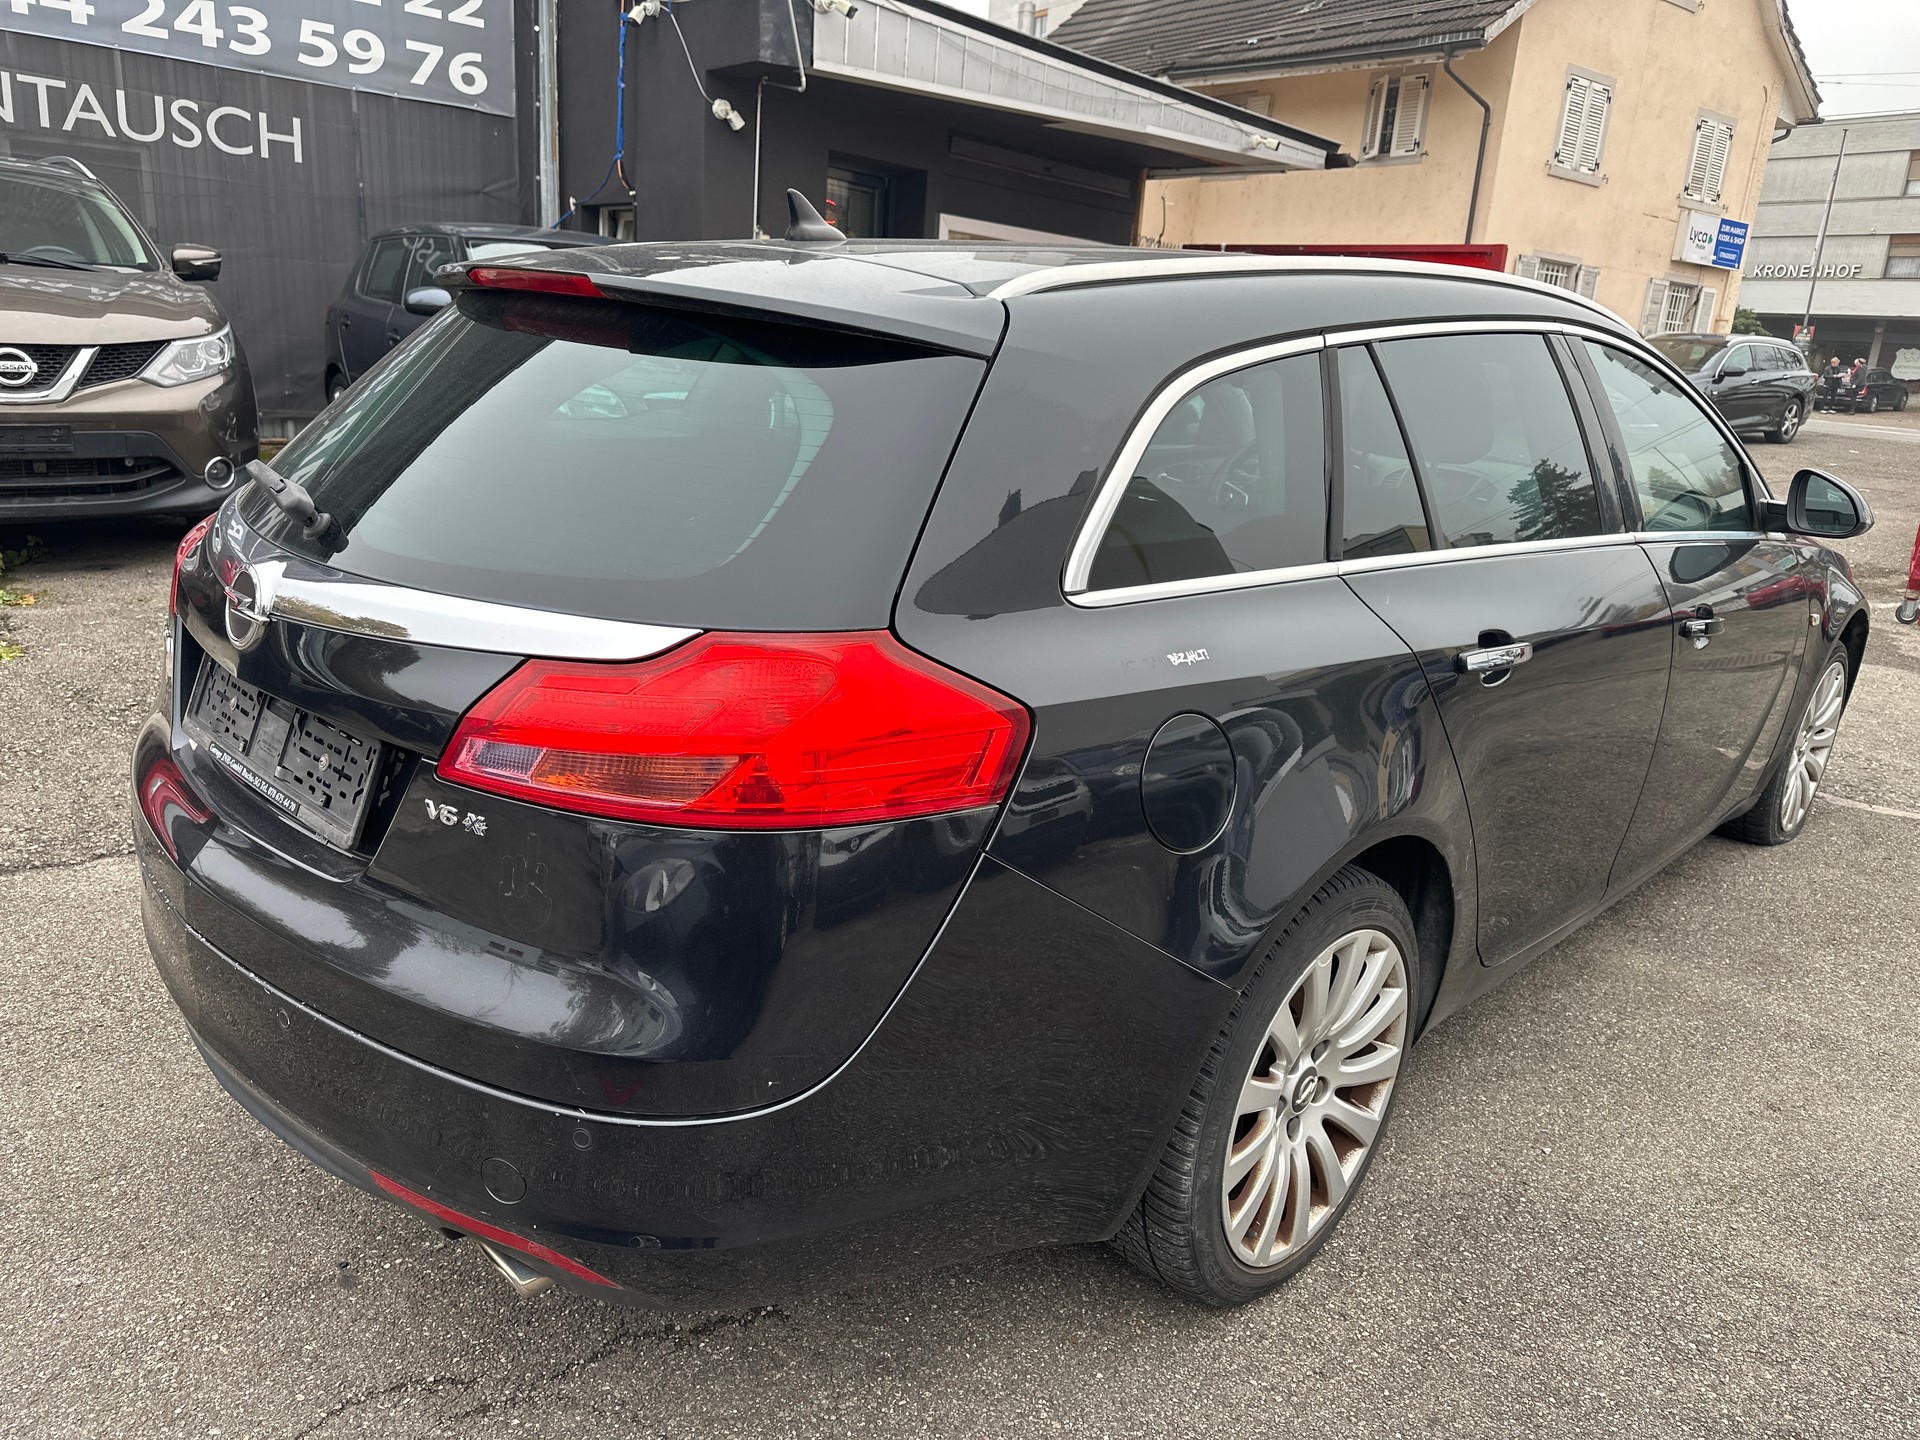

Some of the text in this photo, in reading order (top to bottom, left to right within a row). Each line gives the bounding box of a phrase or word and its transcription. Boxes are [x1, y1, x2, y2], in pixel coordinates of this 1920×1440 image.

[122, 0, 272, 55] 243
[297, 18, 385, 75] 59
[406, 39, 488, 95] 76
[1689, 226, 1708, 244] Lyca
[1730, 226, 1746, 236] MARKET
[1734, 237, 1745, 245] SHOP
[1753, 264, 1862, 278] KRONENHOF
[209, 743, 223, 759] Garage
[424, 798, 458, 826] V6
